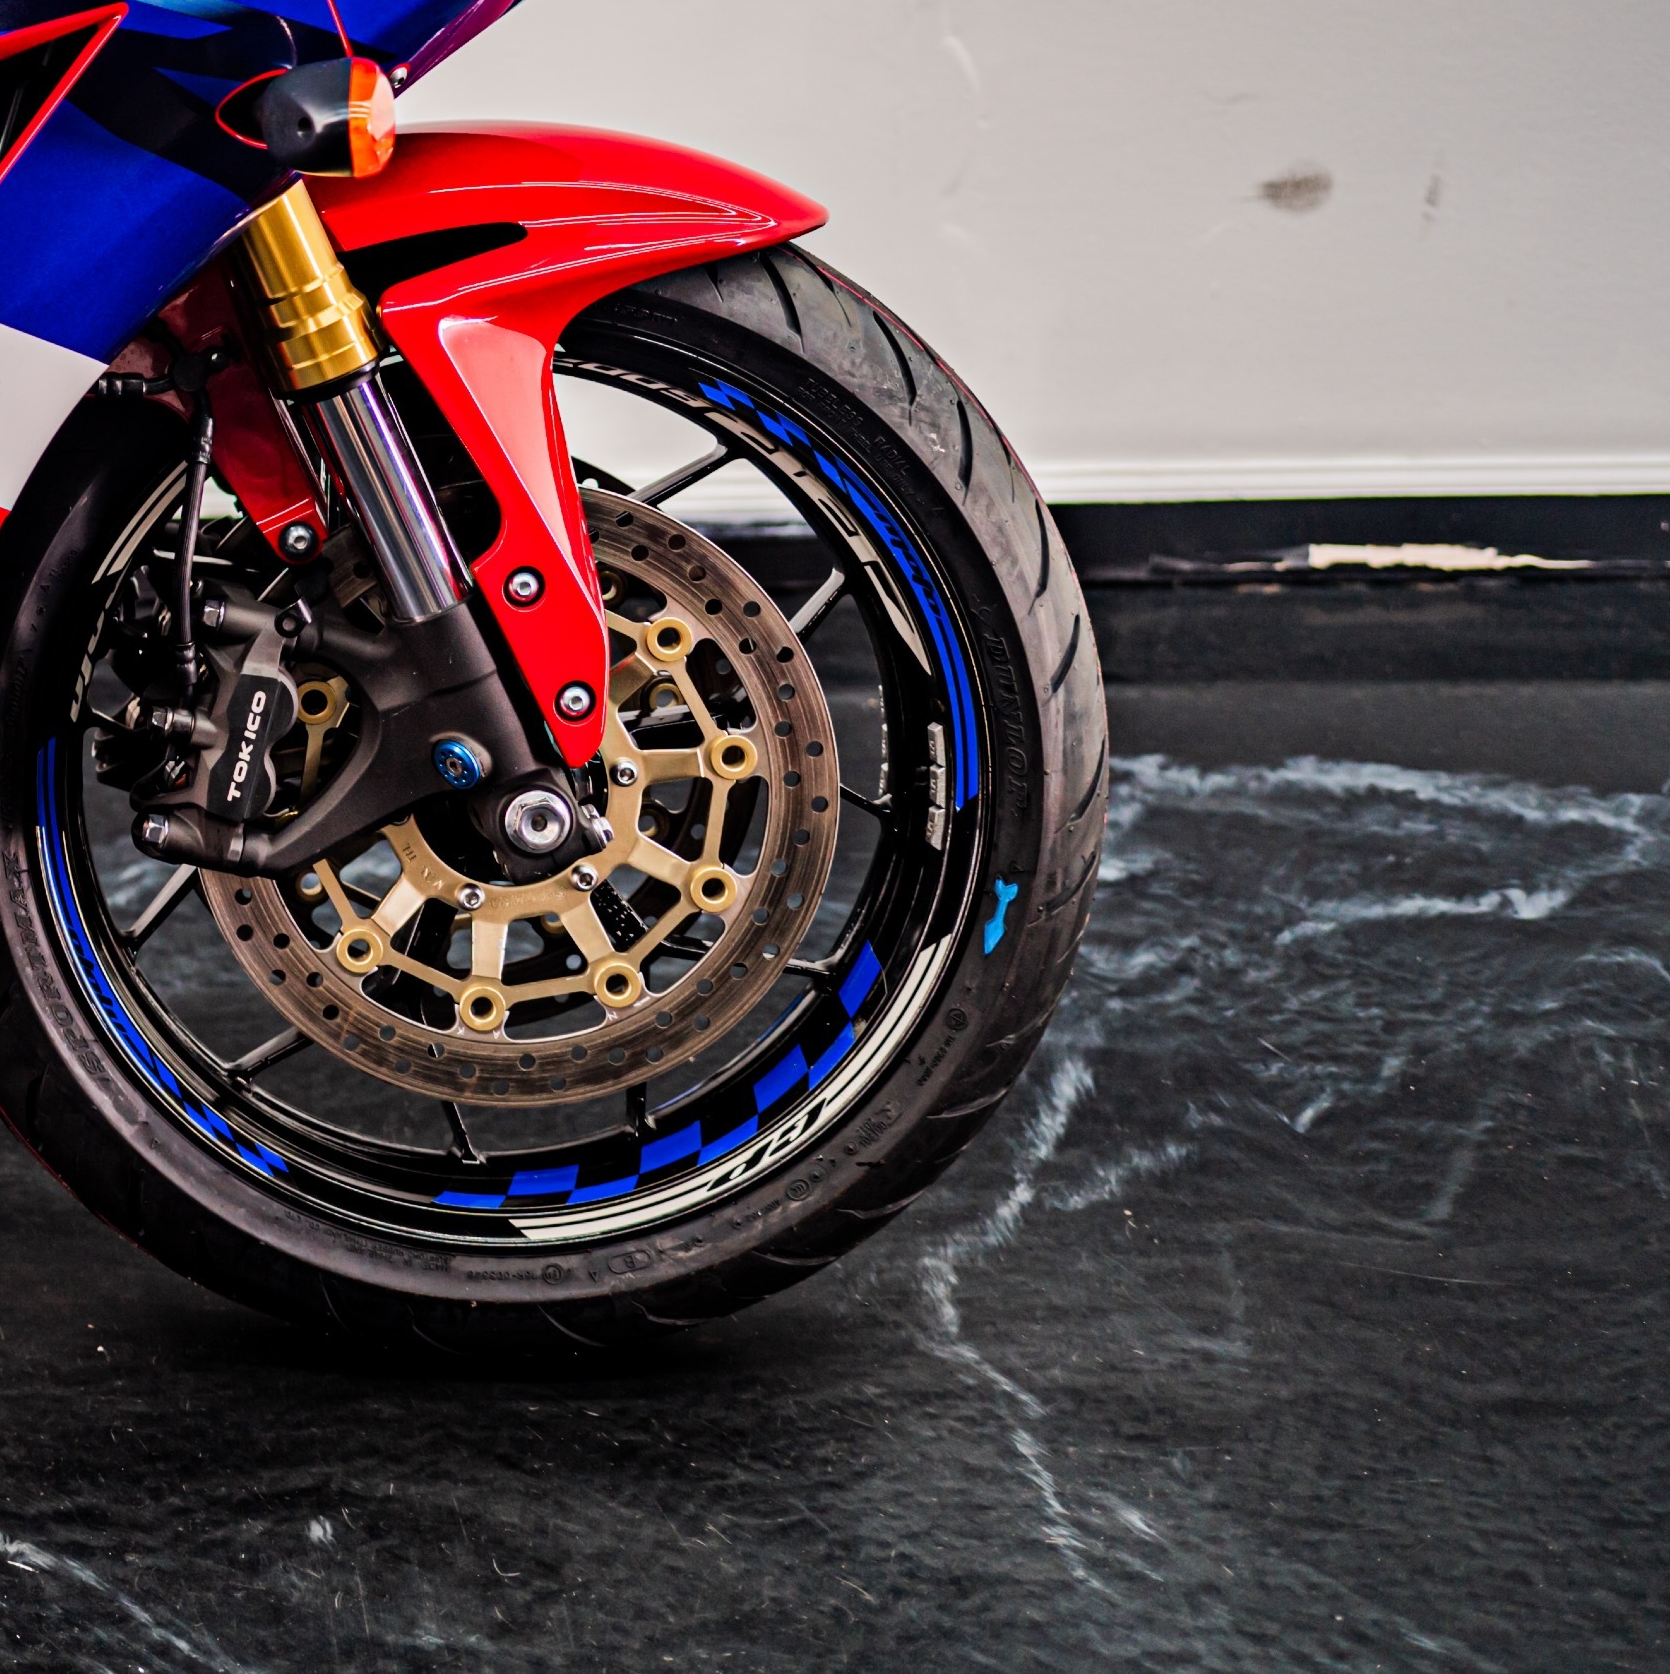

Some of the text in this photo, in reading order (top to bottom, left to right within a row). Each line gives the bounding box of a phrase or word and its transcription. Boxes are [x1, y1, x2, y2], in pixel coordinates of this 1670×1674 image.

[804, 376, 912, 475] TUBELESS RADIAL
[227, 691, 266, 801] TOKICO
[982, 628, 1026, 808] DUNLOP
[1, 849, 106, 1080] SPORTMAX
